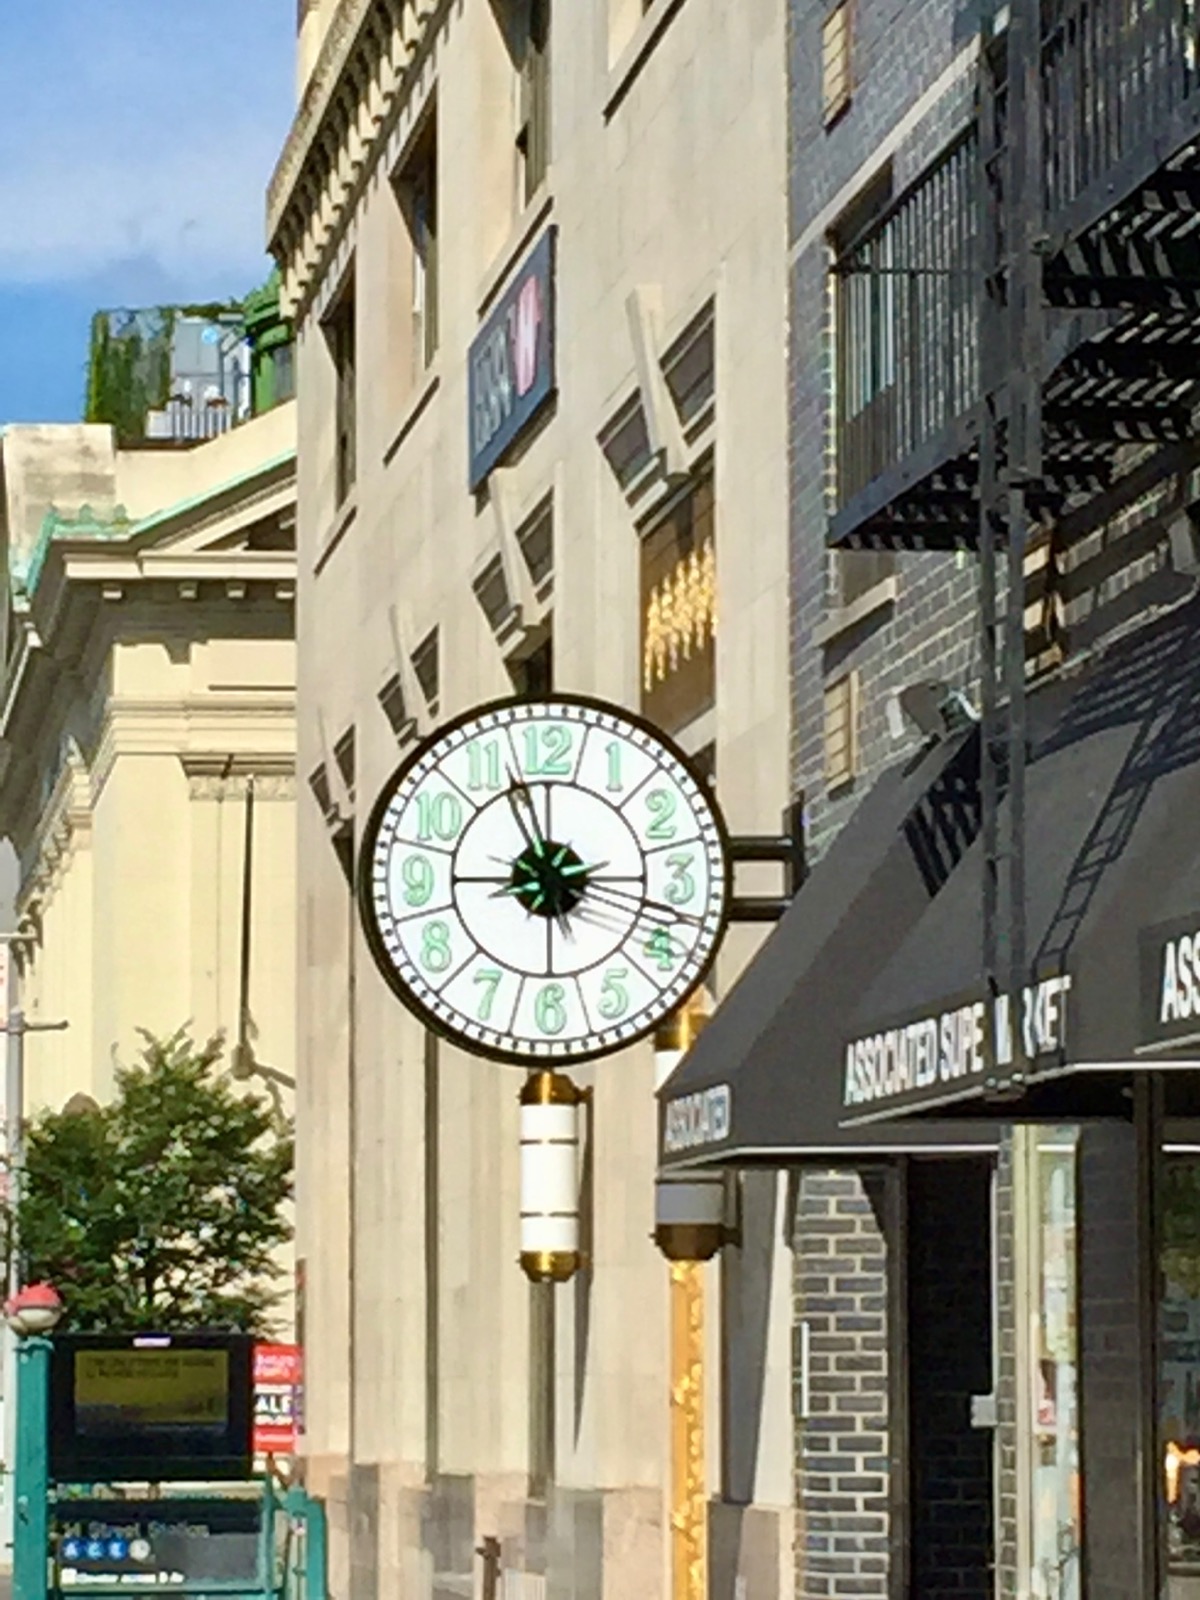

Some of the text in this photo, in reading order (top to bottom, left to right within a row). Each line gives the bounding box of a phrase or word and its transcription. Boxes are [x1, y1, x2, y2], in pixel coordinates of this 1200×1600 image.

[465, 740, 502, 791] 11
[522, 725, 573, 776] 12
[604, 741, 623, 793] 1
[414, 791, 462, 842] 10
[644, 788, 678, 840] 2
[401, 854, 435, 907] 9
[664, 853, 696, 905] 3
[419, 919, 453, 973] 8
[643, 926, 674, 972] 4
[472, 968, 503, 1020] 7
[533, 982, 567, 1035] 6
[596, 967, 630, 1019] 5
[843, 1017, 938, 1107] ASSOCIATED
